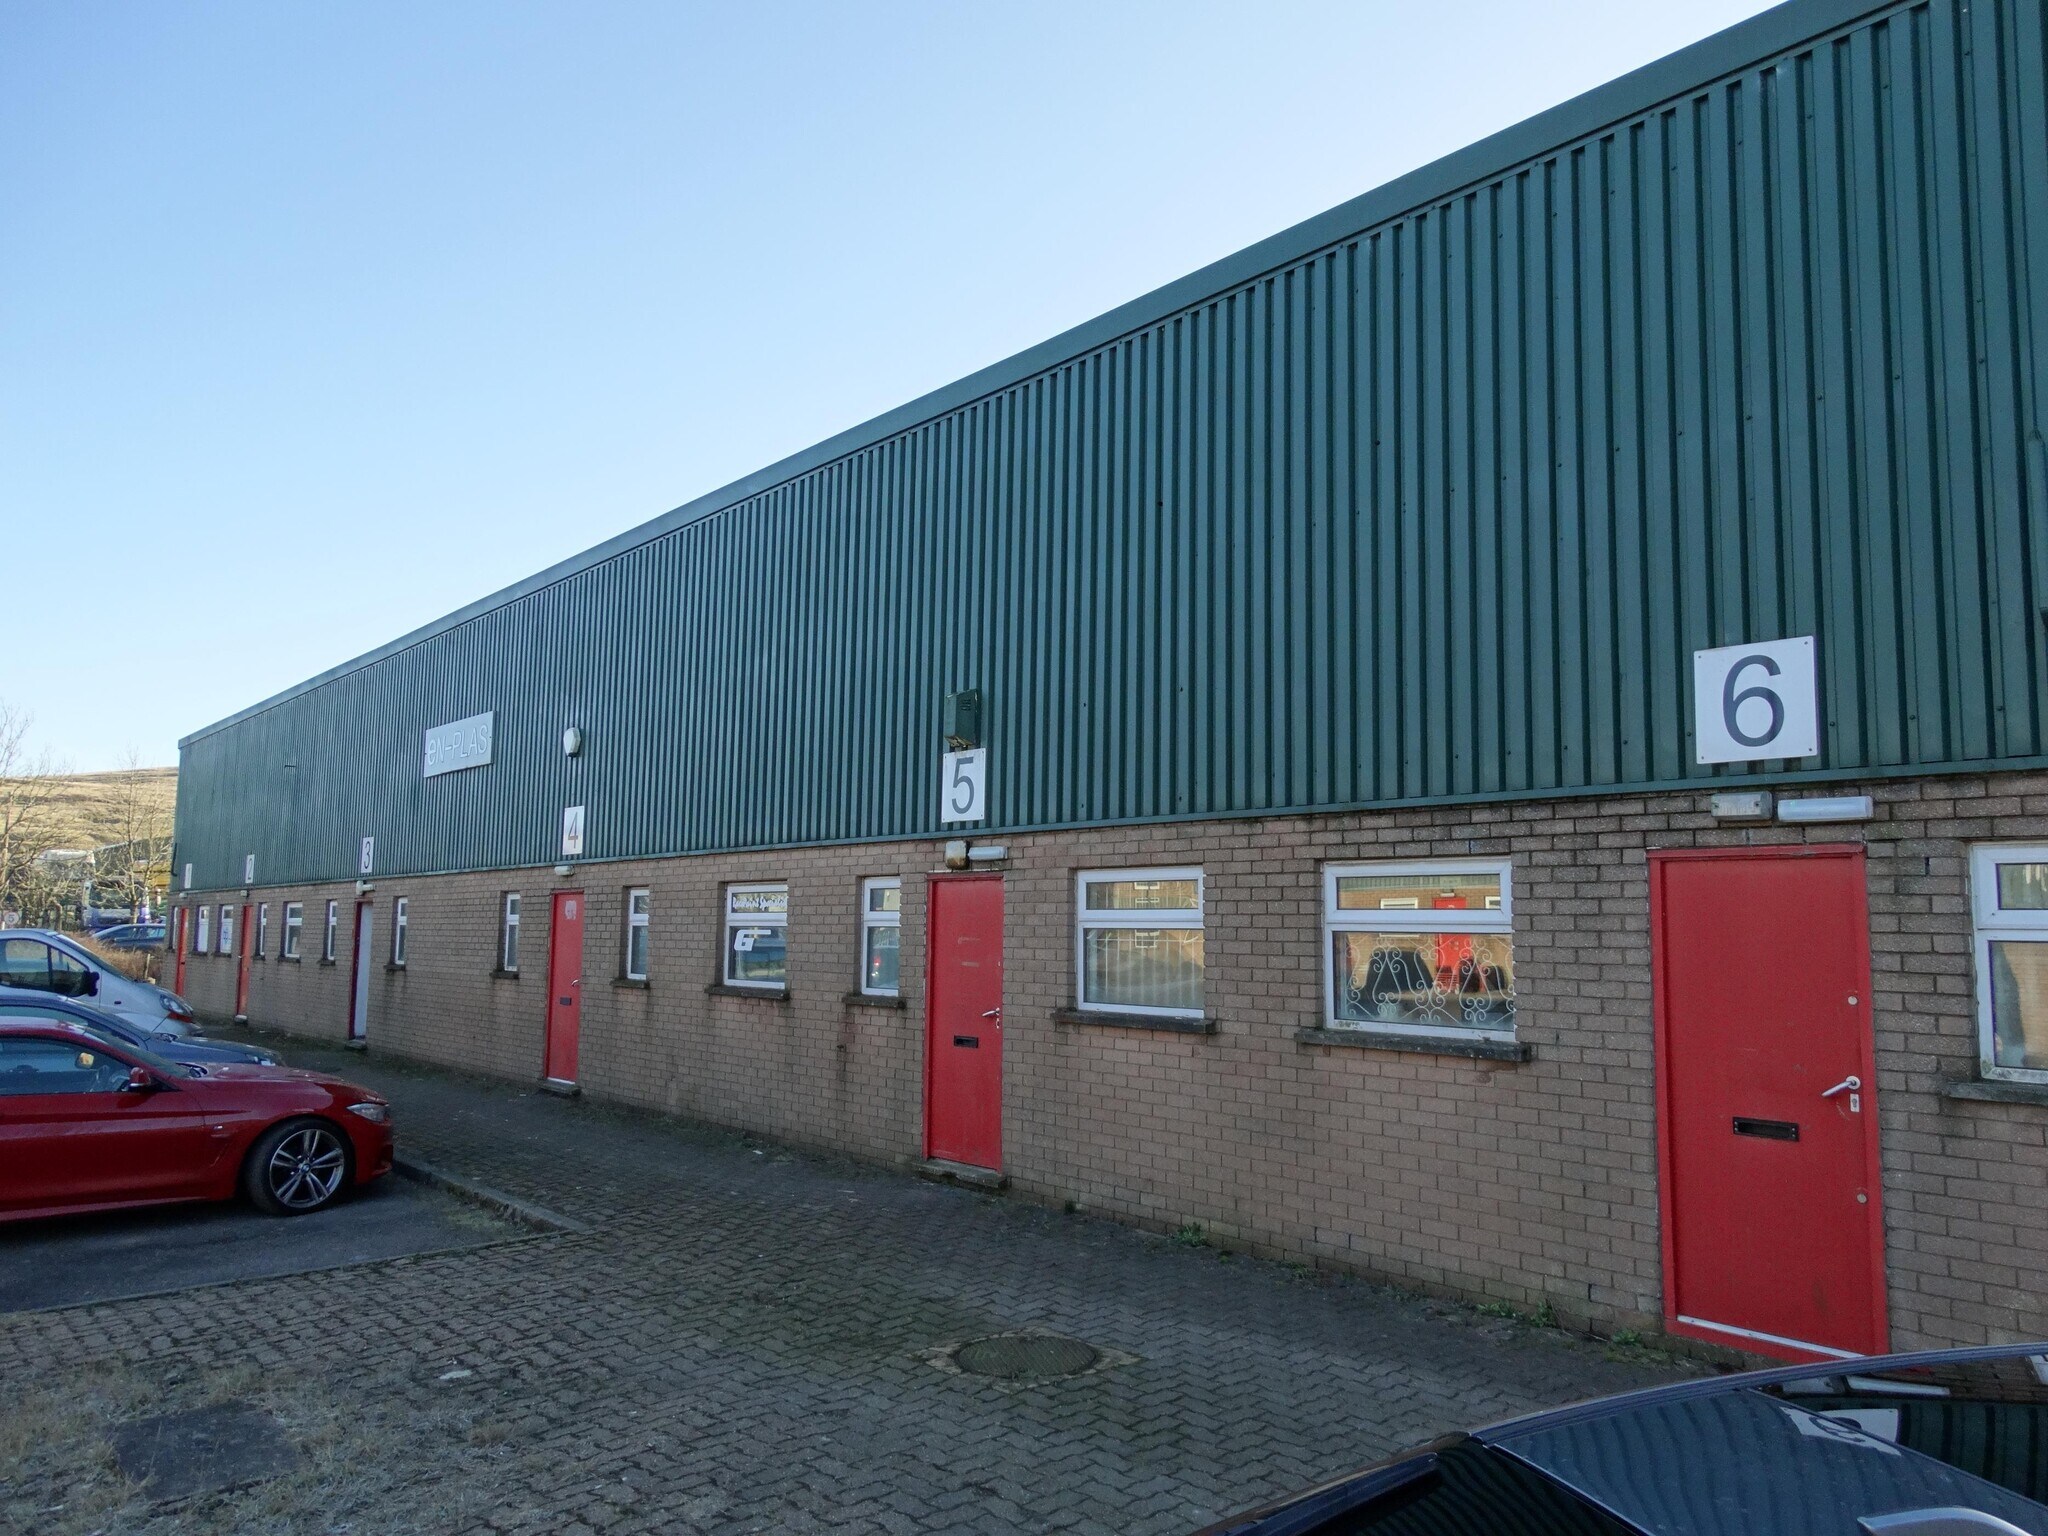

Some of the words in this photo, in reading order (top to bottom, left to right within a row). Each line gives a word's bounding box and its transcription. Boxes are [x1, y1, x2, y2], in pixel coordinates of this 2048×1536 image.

[1723, 654, 1785, 748] 6
[951, 756, 975, 815] 5
[568, 811, 578, 849] 4
[247, 857, 253, 881] 2
[364, 841, 371, 870] 3
